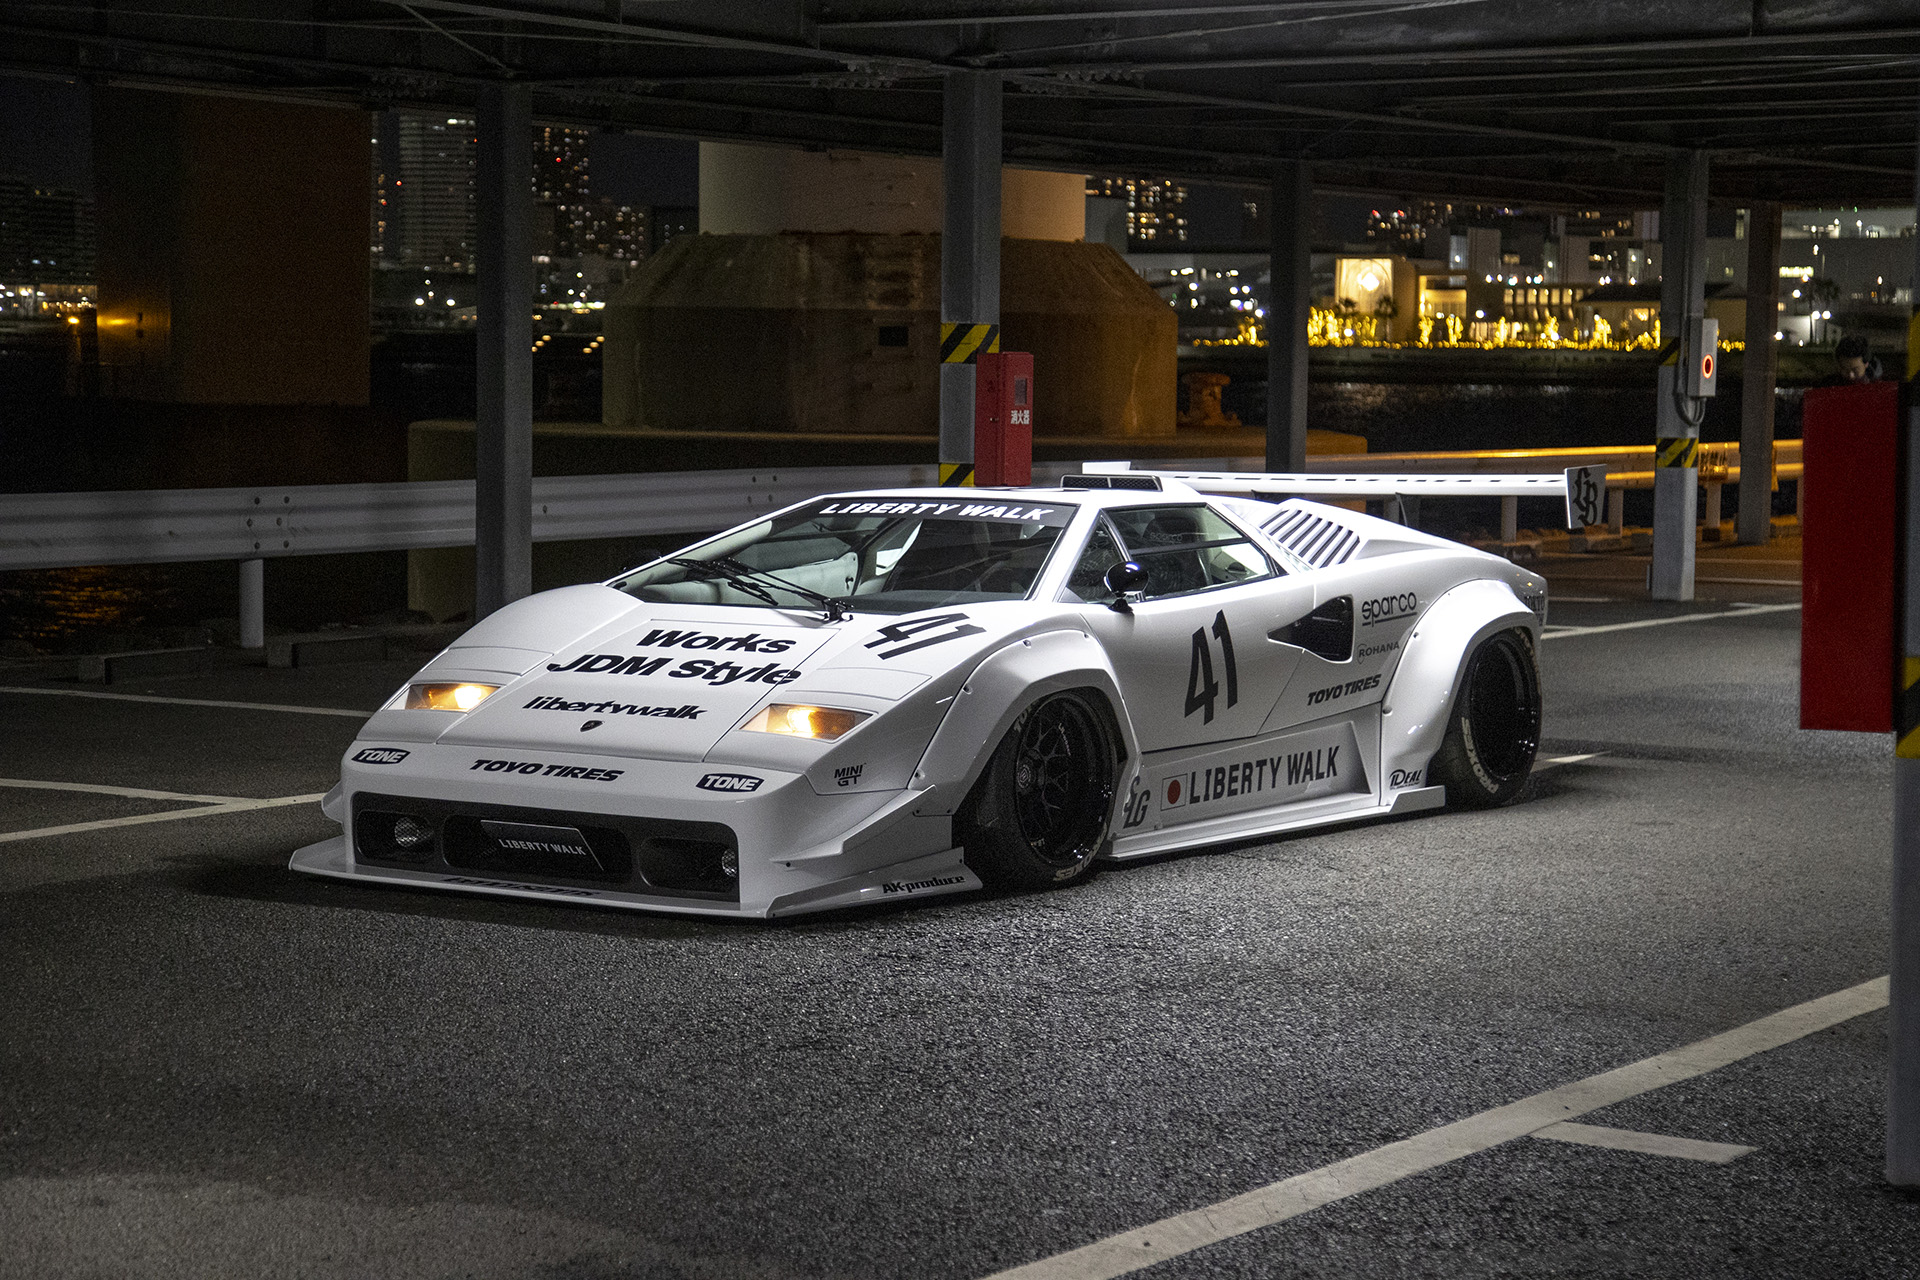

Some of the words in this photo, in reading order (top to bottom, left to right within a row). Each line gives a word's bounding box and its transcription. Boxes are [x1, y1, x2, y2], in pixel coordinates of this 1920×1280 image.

[1010, 409, 1030, 425] 消火器
[818, 502, 961, 517] LIBERTY
[957, 503, 1055, 521] WALK
[1361, 591, 1418, 628] sparco
[635, 628, 797, 654] Works
[863, 612, 987, 661] 41
[1357, 641, 1400, 659] ROHANA
[546, 653, 675, 677] JDM
[667, 658, 802, 686] Style
[1184, 608, 1239, 726] 41
[1307, 684, 1343, 707] TOYO
[1343, 673, 1382, 697] TIRES
[521, 695, 708, 720] libertywalk
[358, 749, 406, 764] TONE
[469, 758, 544, 775] TOYO
[540, 764, 626, 782] TIRES
[833, 764, 864, 779] MINI
[1189, 755, 1283, 805] LIBERTY
[1286, 745, 1341, 786] WALK
[703, 774, 760, 791] TONE
[836, 774, 862, 788] GT
[498, 838, 551, 853] LIBERTY
[549, 843, 587, 856] WALK
[881, 875, 967, 894] AK-produce
